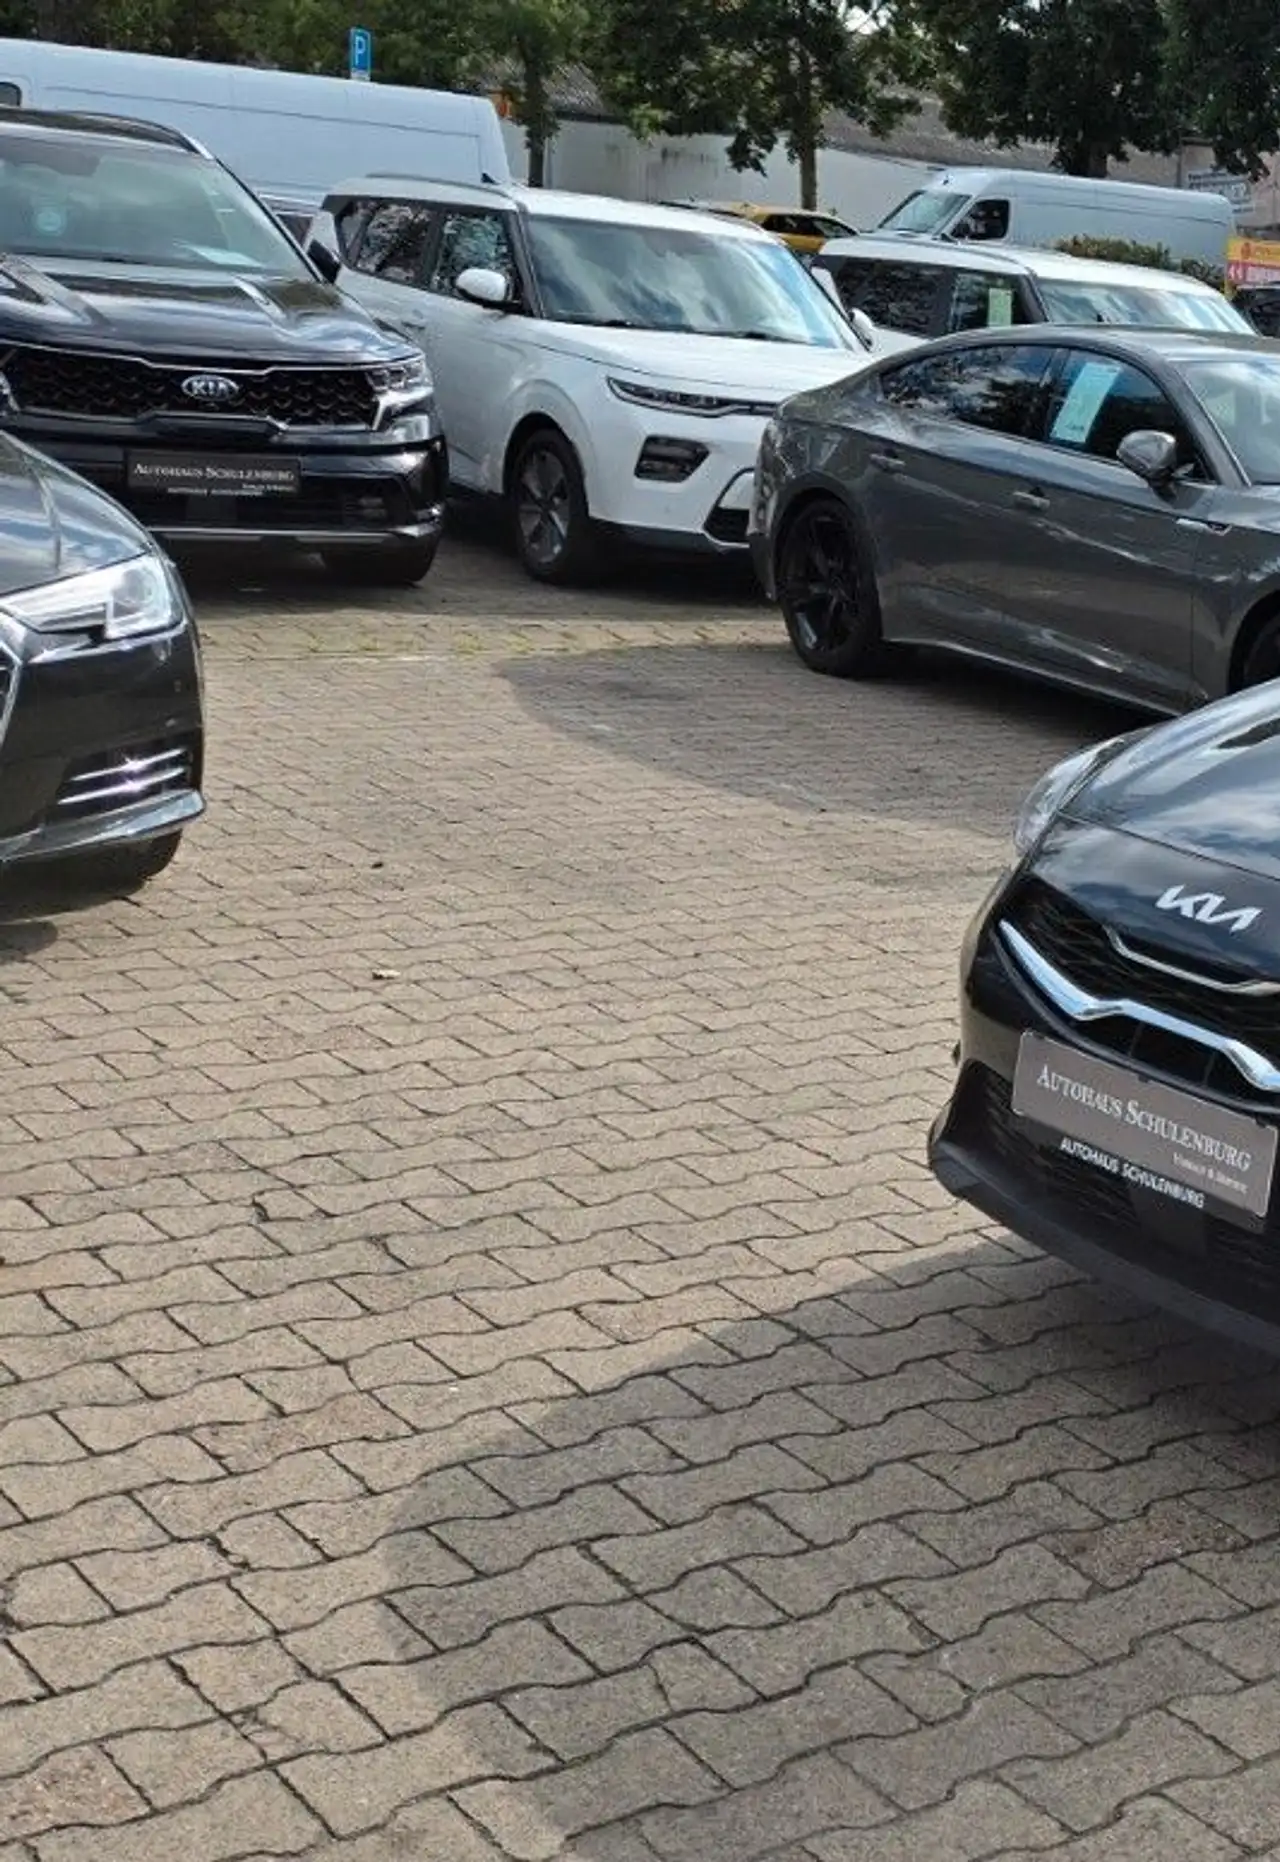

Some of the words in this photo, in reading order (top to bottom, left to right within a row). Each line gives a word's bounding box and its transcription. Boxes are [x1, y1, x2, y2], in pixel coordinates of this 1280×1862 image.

[355, 35, 366, 65] P
[134, 463, 202, 478] AUTOHAUS
[205, 465, 295, 481] SCHULENBURG
[1155, 884, 1262, 934] KIA
[1036, 1064, 1122, 1117] AUTOHAUS
[1123, 1099, 1253, 1172] SCHULENBURG
[1060, 1137, 1119, 1174] AUTOHAUS
[1121, 1162, 1206, 1210] SCHULENBURG
